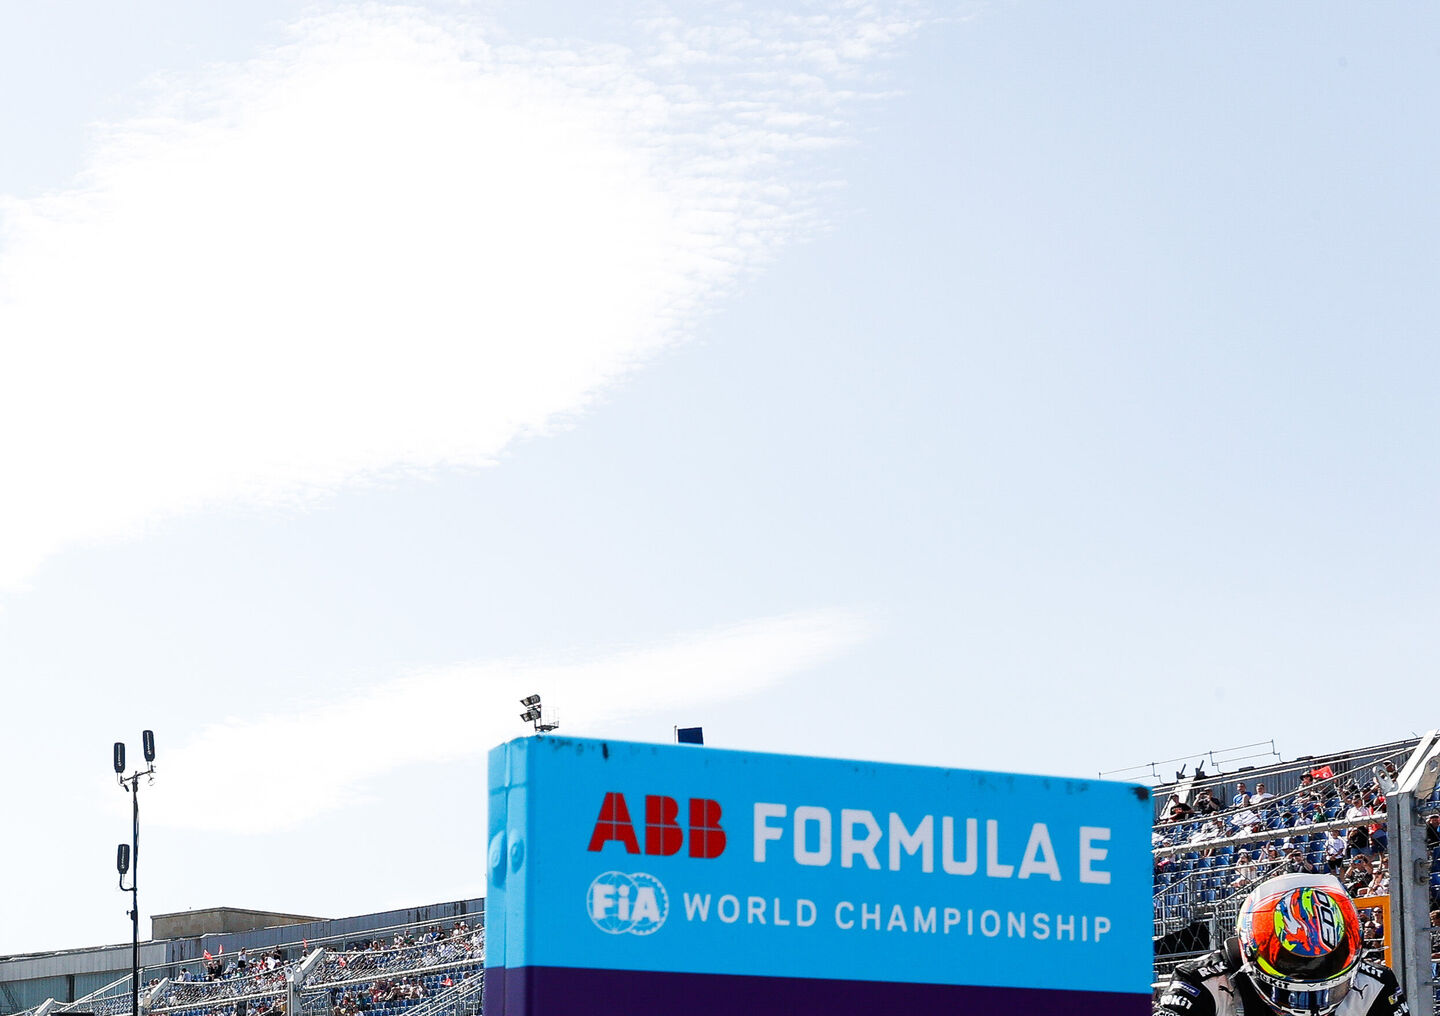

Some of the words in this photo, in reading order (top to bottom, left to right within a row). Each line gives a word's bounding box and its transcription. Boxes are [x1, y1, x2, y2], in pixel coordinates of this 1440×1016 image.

[586, 791, 727, 860] ABB
[752, 802, 1062, 883] FORMULA
[1078, 825, 1112, 886] E
[683, 892, 818, 928] WORLD
[834, 900, 1113, 944] CHAMPIONSHIP
